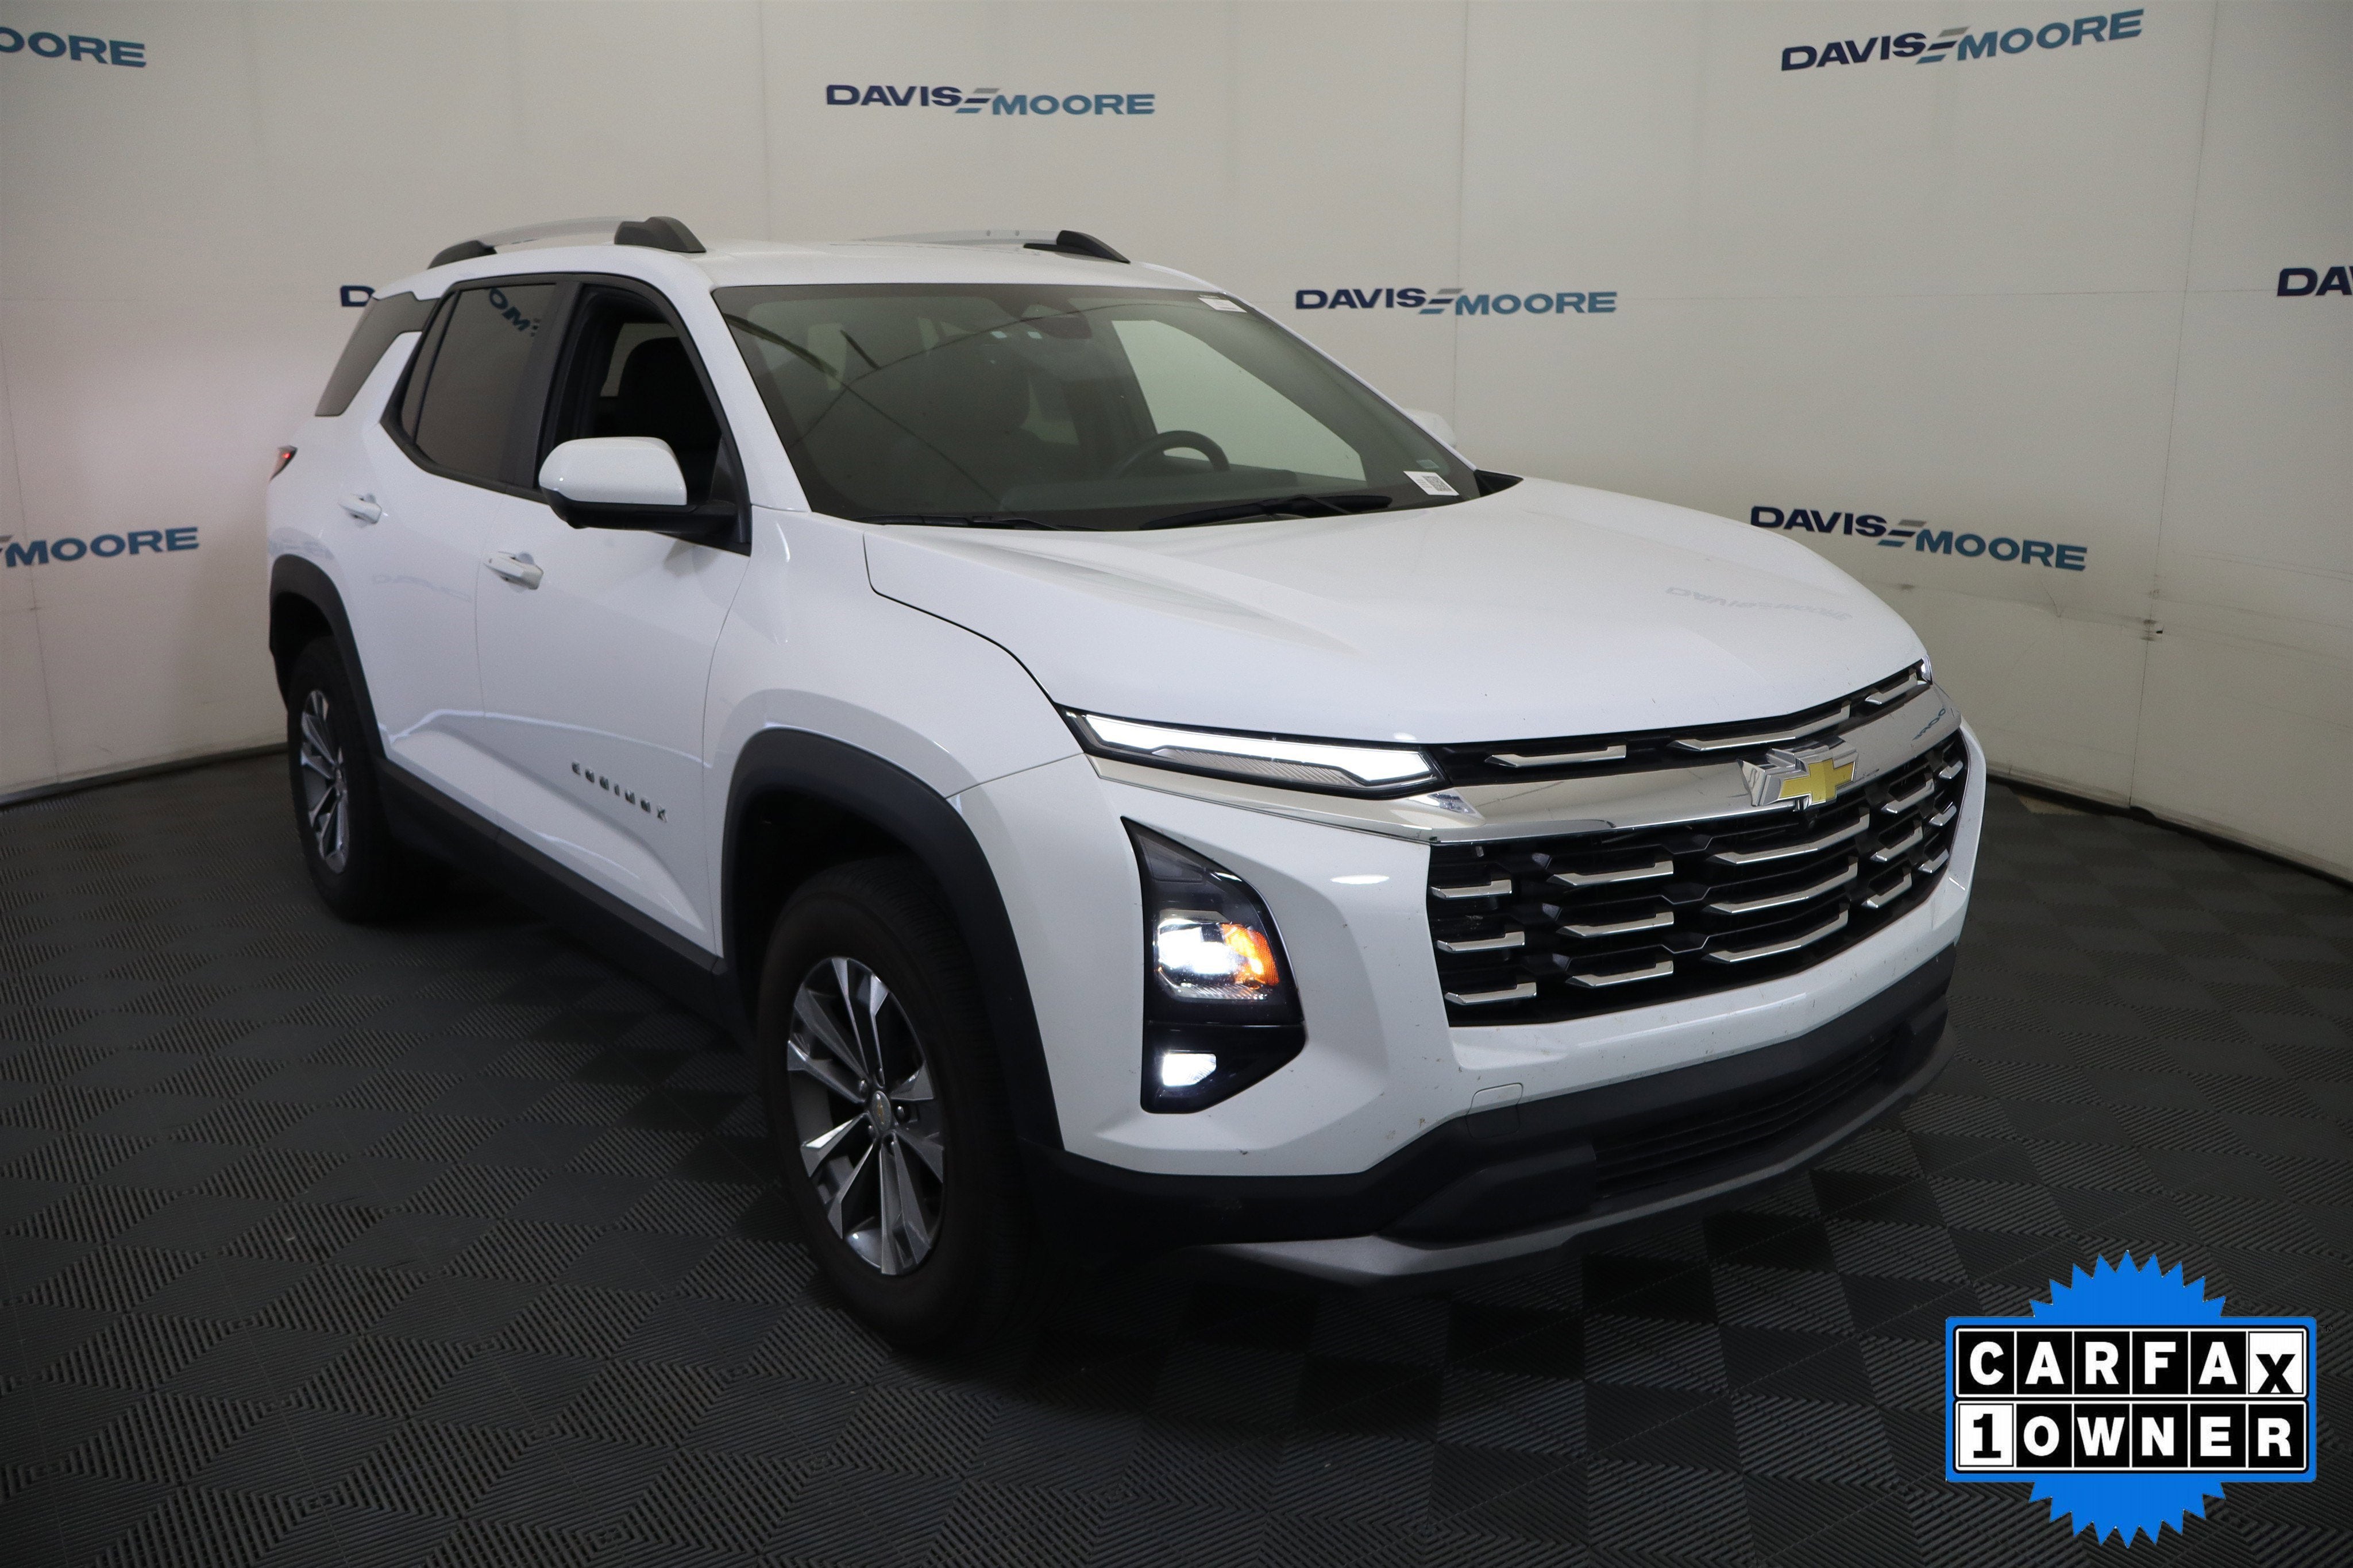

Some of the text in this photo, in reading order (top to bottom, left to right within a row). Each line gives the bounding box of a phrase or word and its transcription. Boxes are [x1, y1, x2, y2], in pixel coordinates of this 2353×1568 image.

[1781, 9, 2144, 71] DAVIS MOORE
[826, 84, 1155, 115] DAVIS MOORE
[2277, 266, 2353, 296] DA
[1295, 288, 1618, 316] DAVIS MOORE
[5, 527, 199, 568] MOORE
[1750, 505, 2088, 571] DAVIS MOORE
